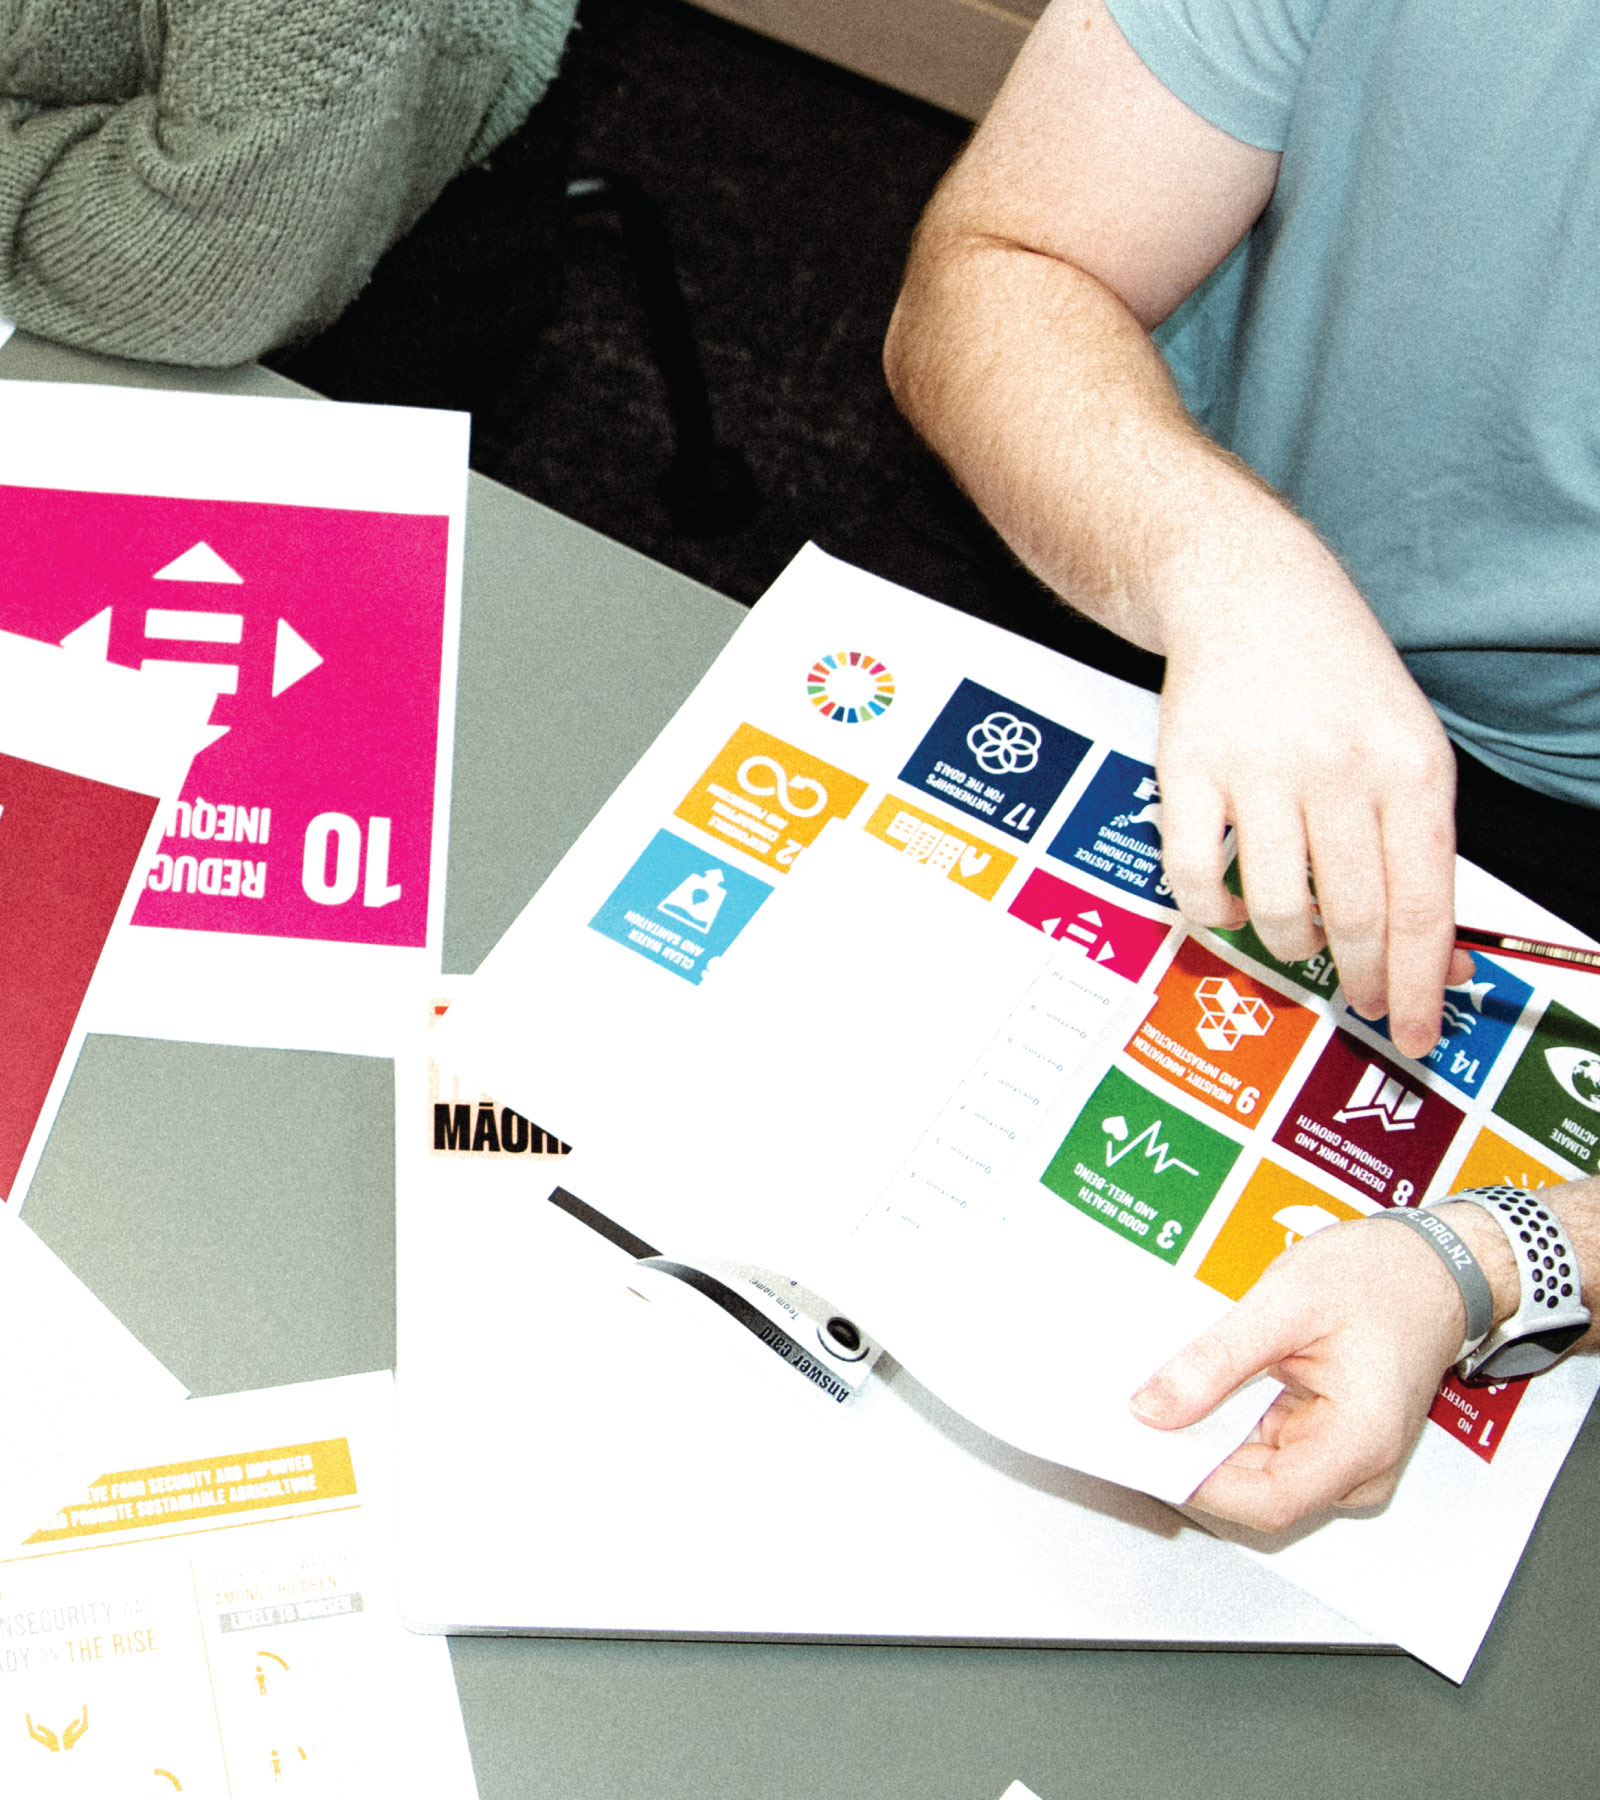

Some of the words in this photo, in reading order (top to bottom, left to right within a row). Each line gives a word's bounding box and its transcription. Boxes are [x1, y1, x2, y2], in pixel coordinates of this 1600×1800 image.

[933, 760, 969, 784] GOALS
[963, 772, 987, 793] THE
[925, 773, 998, 817] PARTNERSHIPS
[985, 783, 1006, 804] FOR
[1002, 802, 1037, 832] 17
[302, 812, 402, 908] 10
[1073, 846, 1114, 873] JUSTICE
[1093, 839, 1134, 865] STRONG
[1133, 857, 1157, 874] AND
[147, 853, 267, 899] REDUC
[623, 909, 682, 946] SANITATION
[627, 928, 664, 954] WATER
[661, 946, 696, 971] CLEAN
[680, 938, 706, 957] AND
[1302, 954, 1336, 986] 15
[1132, 1035, 1187, 1077] INNOVATION
[1141, 1020, 1221, 1080] INFRASTRUCTURE
[1449, 1048, 1480, 1084] 14
[1184, 1068, 1234, 1105] INDUSTRY,
[1218, 1071, 1243, 1091] AND
[1236, 1086, 1261, 1114] 9
[1294, 1132, 1319, 1152] AND
[1296, 1114, 1342, 1147] GROWTH
[1550, 1127, 1591, 1161] CLIMATE
[1561, 1117, 1599, 1146] ACTION
[1316, 1144, 1350, 1170] WORK
[1341, 1140, 1394, 1179] ECONOMIC
[1073, 1162, 1135, 1208] WELL-BEING
[1347, 1163, 1387, 1193] DECENT
[1077, 1186, 1119, 1218] HEALTH
[1392, 1179, 1415, 1207] 8
[1117, 1210, 1150, 1236] GOOD
[1133, 1200, 1159, 1221] AND
[1156, 1219, 1183, 1250] 3
[775, 1297, 800, 1321] Team
[759, 1325, 793, 1358] card
[791, 1354, 850, 1404] Answer
[1457, 1417, 1473, 1435] NO
[1478, 1419, 1495, 1447] 1
[148, 1469, 211, 1494] SECURITY
[64, 1634, 105, 1664] THE
[111, 1626, 160, 1657] RISE
